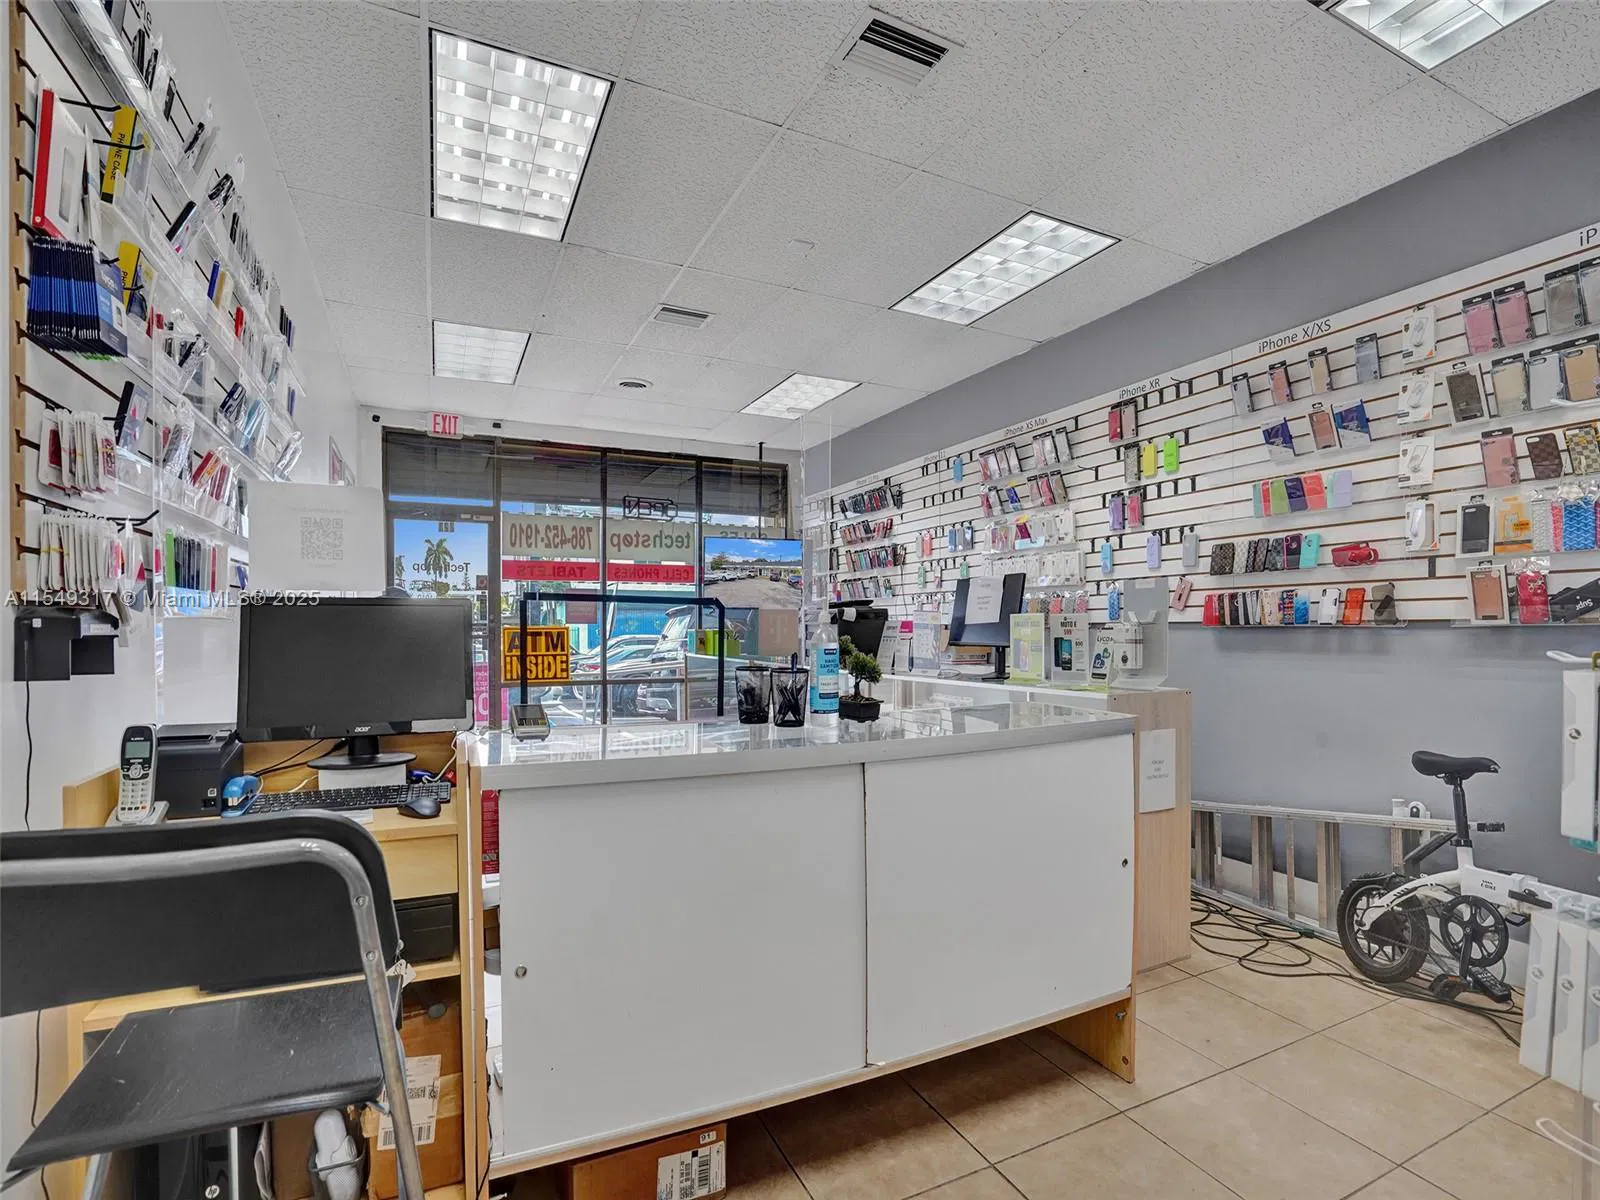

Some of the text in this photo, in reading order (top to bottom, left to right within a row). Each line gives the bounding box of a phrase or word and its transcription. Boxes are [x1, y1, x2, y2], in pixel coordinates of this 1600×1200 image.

[114, 133, 126, 158] PHNE
[1258, 319, 1332, 353] iPhone X/XS
[1119, 378, 1160, 400] iPhone XR
[432, 413, 459, 435] EXIT
[508, 631, 566, 653] ATM
[506, 655, 567, 680] INSIDE
